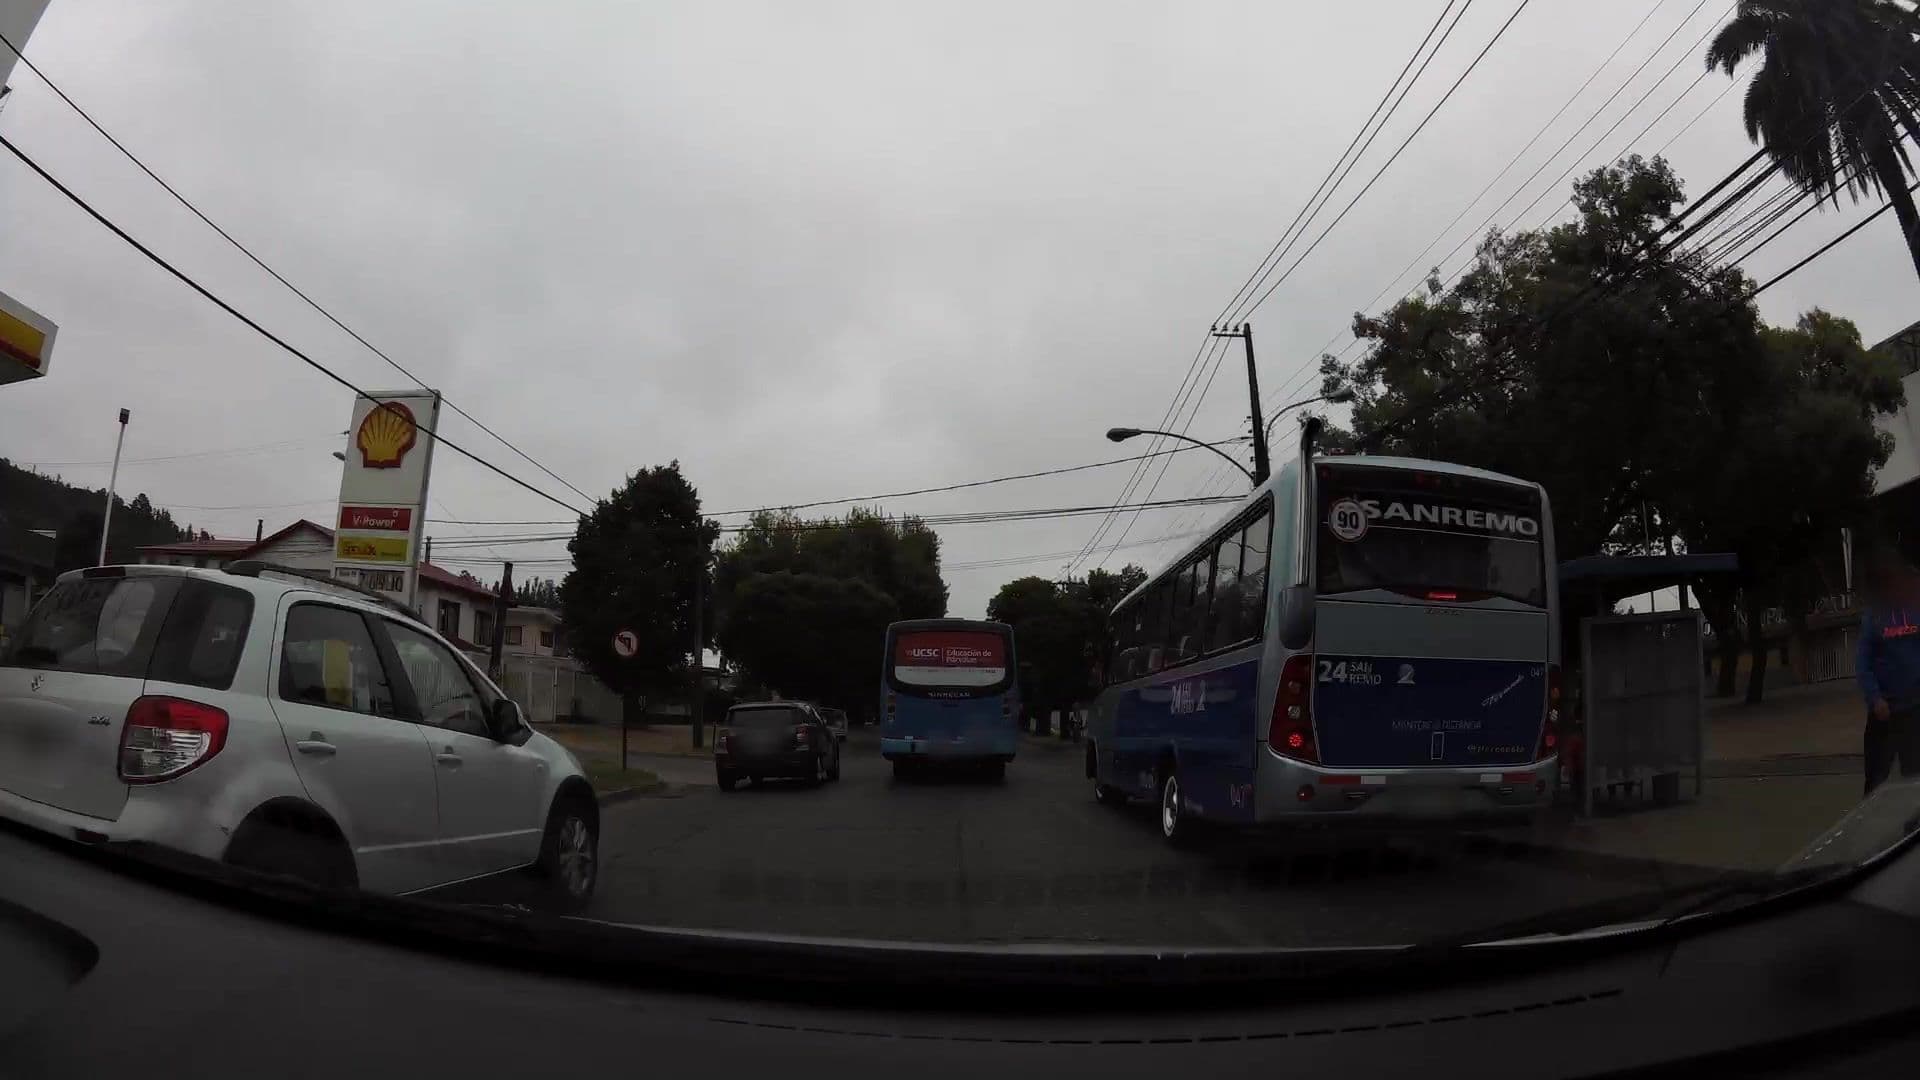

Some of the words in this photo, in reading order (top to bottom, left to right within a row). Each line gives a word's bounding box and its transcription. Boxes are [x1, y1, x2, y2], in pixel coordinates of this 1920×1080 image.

[1337, 511, 1359, 530] 90
[1361, 499, 1538, 536] SANREMO
[982, 648, 992, 657] de
[1319, 660, 1348, 683] 24
[1350, 661, 1373, 674] SAN
[1350, 672, 1382, 686] REMO
